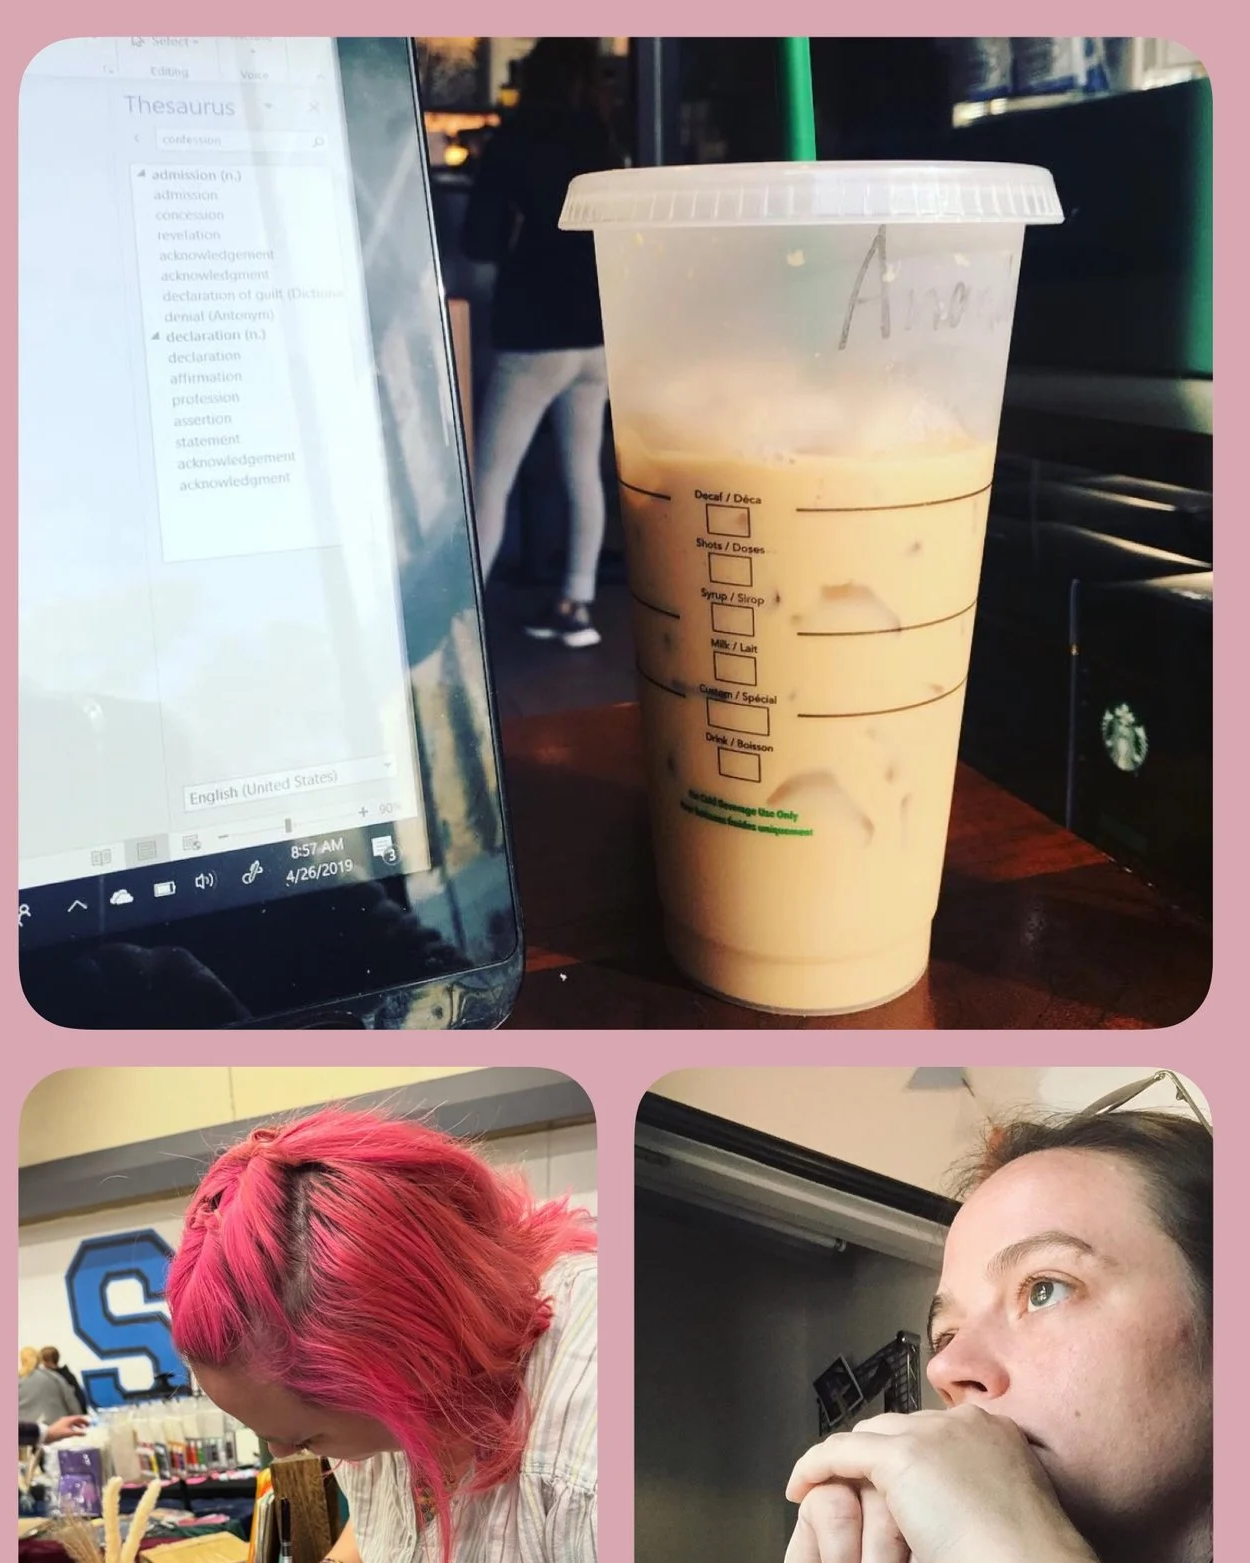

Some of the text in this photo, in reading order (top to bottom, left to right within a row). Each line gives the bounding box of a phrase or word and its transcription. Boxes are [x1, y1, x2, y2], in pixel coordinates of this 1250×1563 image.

[150, 66, 189, 79] Editing
[240, 70, 270, 80] Voice
[124, 95, 236, 116] Thesaurus
[162, 134, 222, 146] confession
[152, 169, 242, 183] admission (n.)
[154, 188, 218, 201] admission
[155, 209, 225, 221] concession
[157, 228, 221, 241] revelation
[159, 249, 275, 263] acknowledgement
[161, 268, 270, 283] acknowledgment
[162, 288, 236, 303] declaration
[238, 289, 253, 302] of
[255, 287, 283, 303] guilt
[164, 308, 275, 324] denial (Antonym)
[166, 327, 267, 343] declaration (n.)
[168, 349, 242, 364] declaration
[170, 370, 243, 385] affirmation
[172, 391, 240, 408] profession
[174, 412, 232, 427] assertion
[175, 433, 241, 448] statement
[177, 450, 296, 470] acknowledgement
[179, 471, 291, 492] acknowledgment
[694, 489, 723, 503] Decaf
[733, 491, 762, 505] Déca
[696, 538, 721, 552] Shots
[732, 542, 766, 555] Doses
[701, 587, 727, 604] Syrup
[737, 590, 765, 607] Sirop
[710, 638, 729, 650] Milk
[740, 642, 758, 654] Lait
[699, 683, 733, 700] Custom
[742, 689, 778, 705] Spécial
[706, 732, 729, 746] Drink
[737, 738, 774, 752] Boisson
[189, 769, 339, 807] English (United States)
[758, 807, 775, 818] Use
[776, 809, 799, 822] Only
[291, 837, 345, 860] 8:57 AM
[285, 858, 354, 882] 4/26/2019
